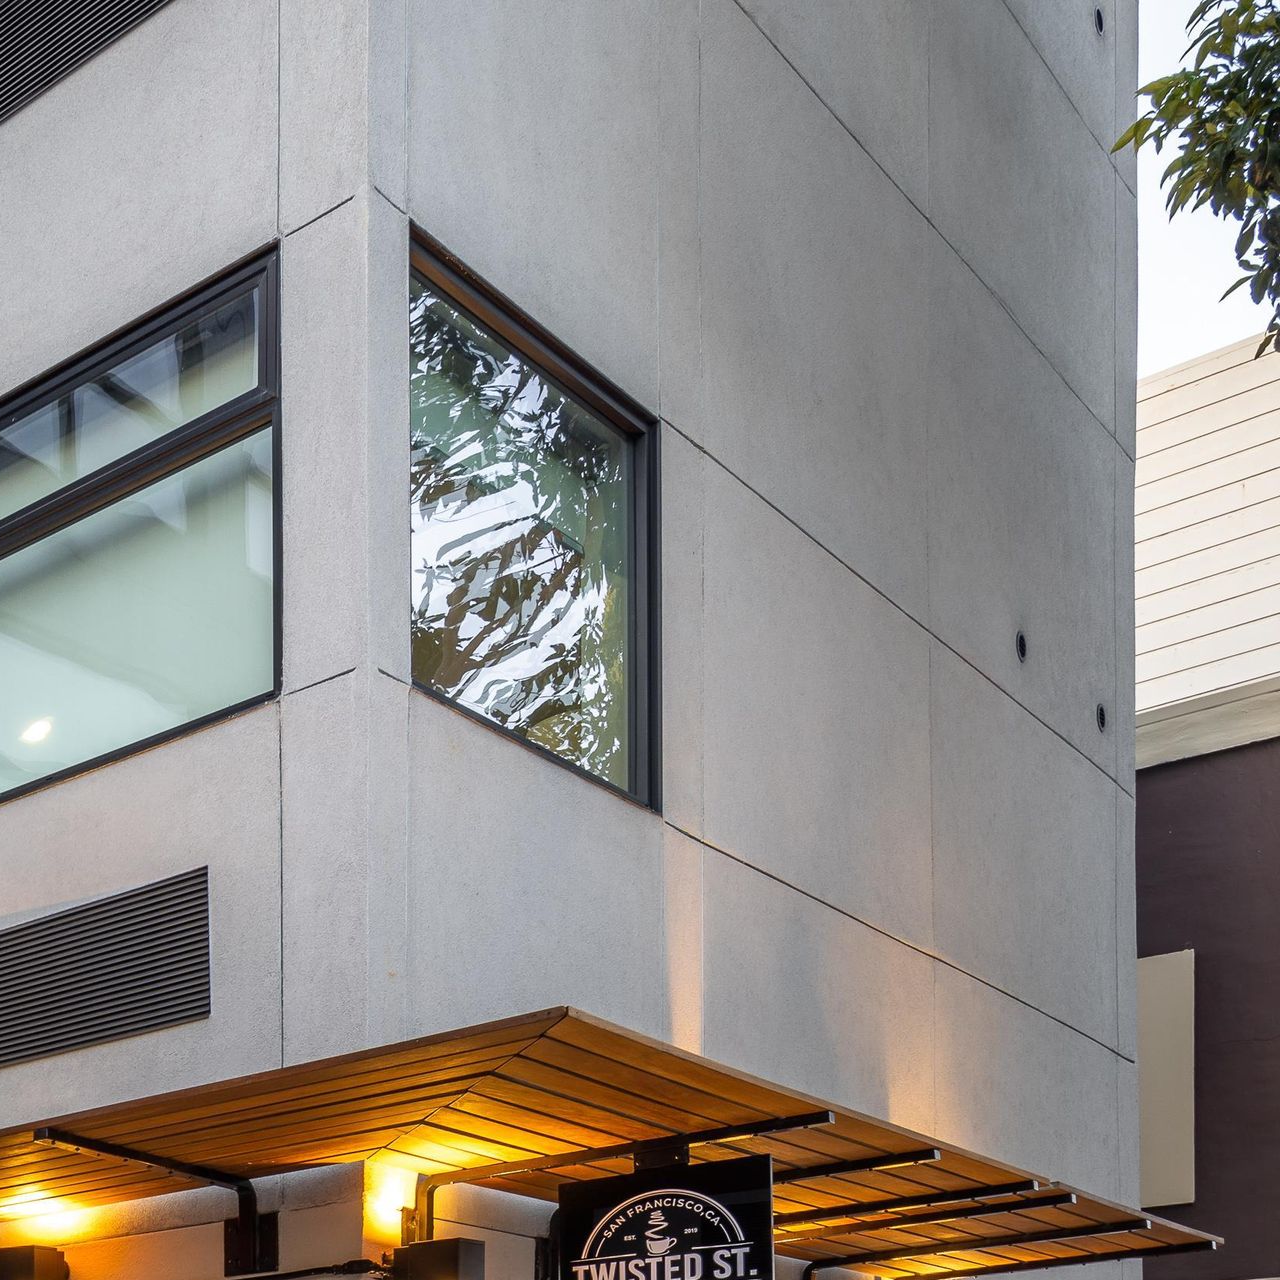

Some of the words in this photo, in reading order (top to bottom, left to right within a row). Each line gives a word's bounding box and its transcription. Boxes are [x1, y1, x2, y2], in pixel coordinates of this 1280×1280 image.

[603, 1216, 626, 1239] SAN
[684, 1227, 698, 1235] 2019
[712, 1247, 758, 1280] ST.
